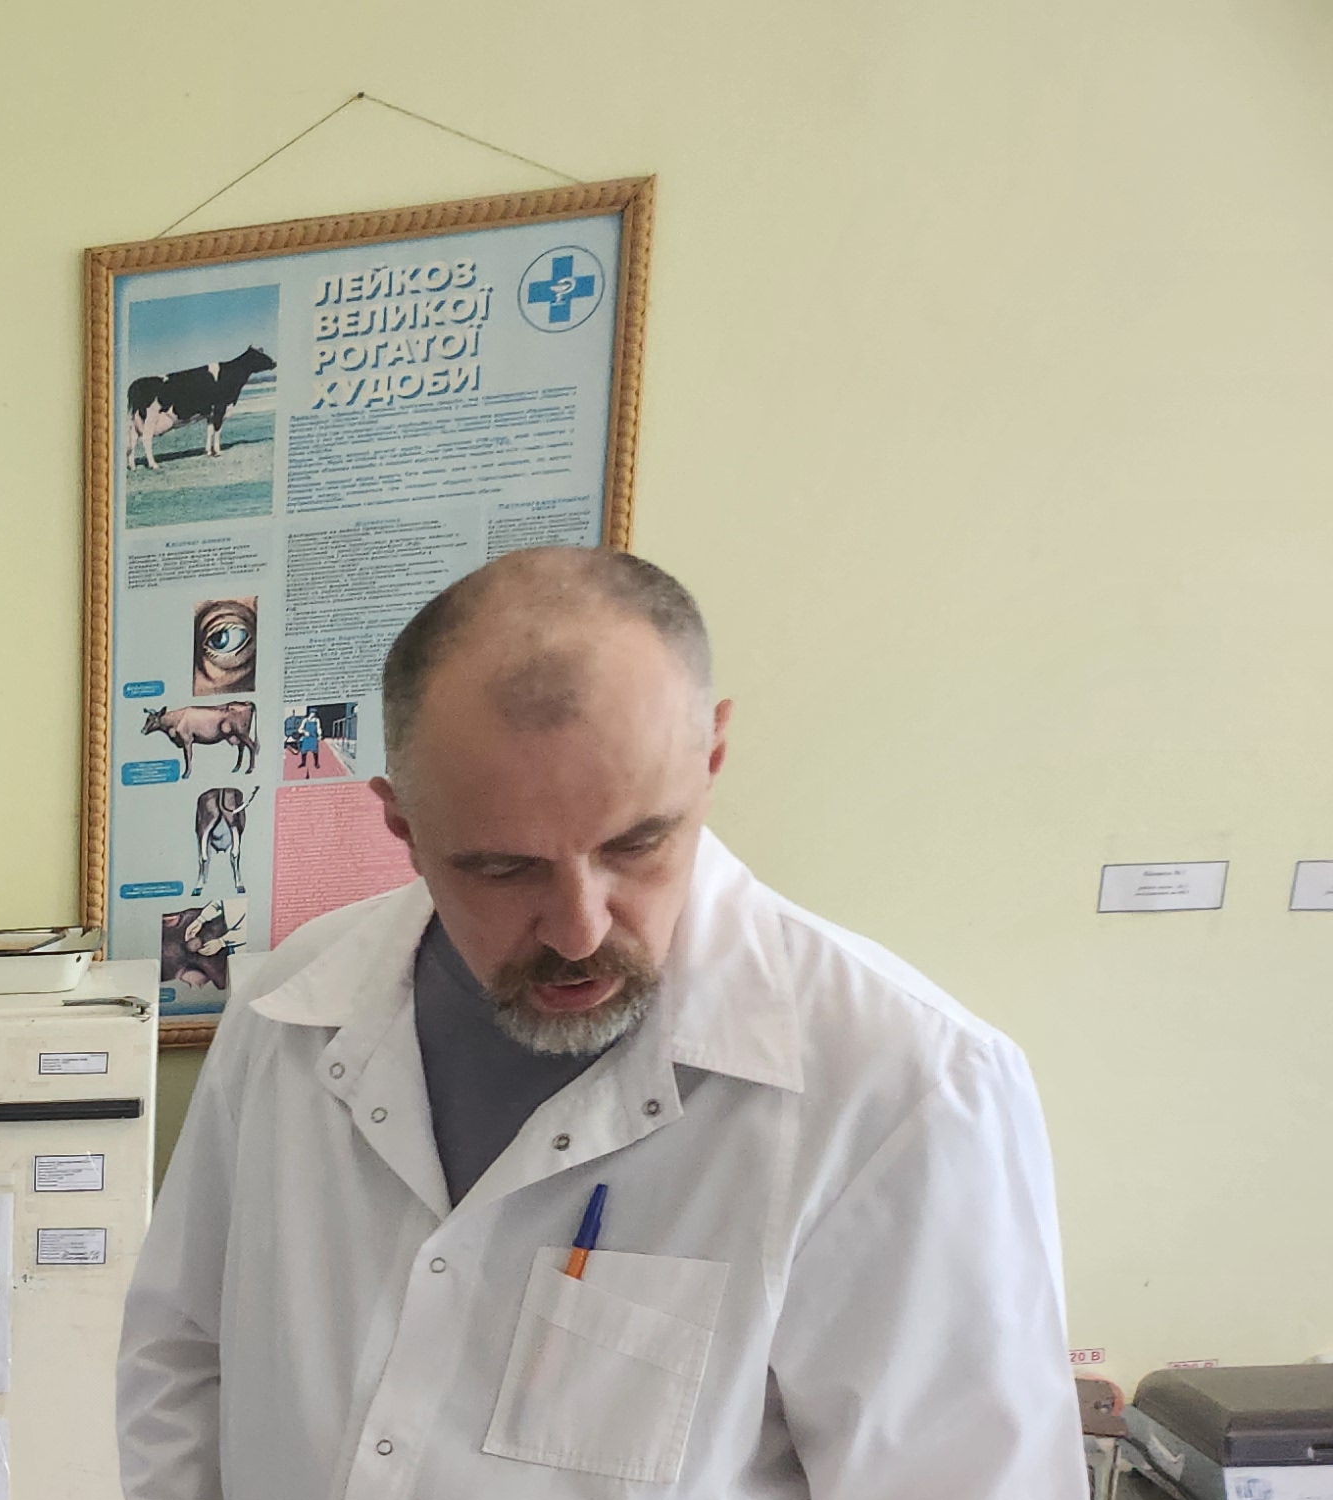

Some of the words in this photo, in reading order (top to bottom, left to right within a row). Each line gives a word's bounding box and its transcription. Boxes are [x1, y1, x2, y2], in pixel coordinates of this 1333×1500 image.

[314, 257, 477, 307] ЛЕЙКОЗ
[312, 284, 494, 342] ВЕЛИКОЇ
[312, 323, 484, 375] РОГАТОЇ
[312, 364, 481, 410] ХУДОБИ
